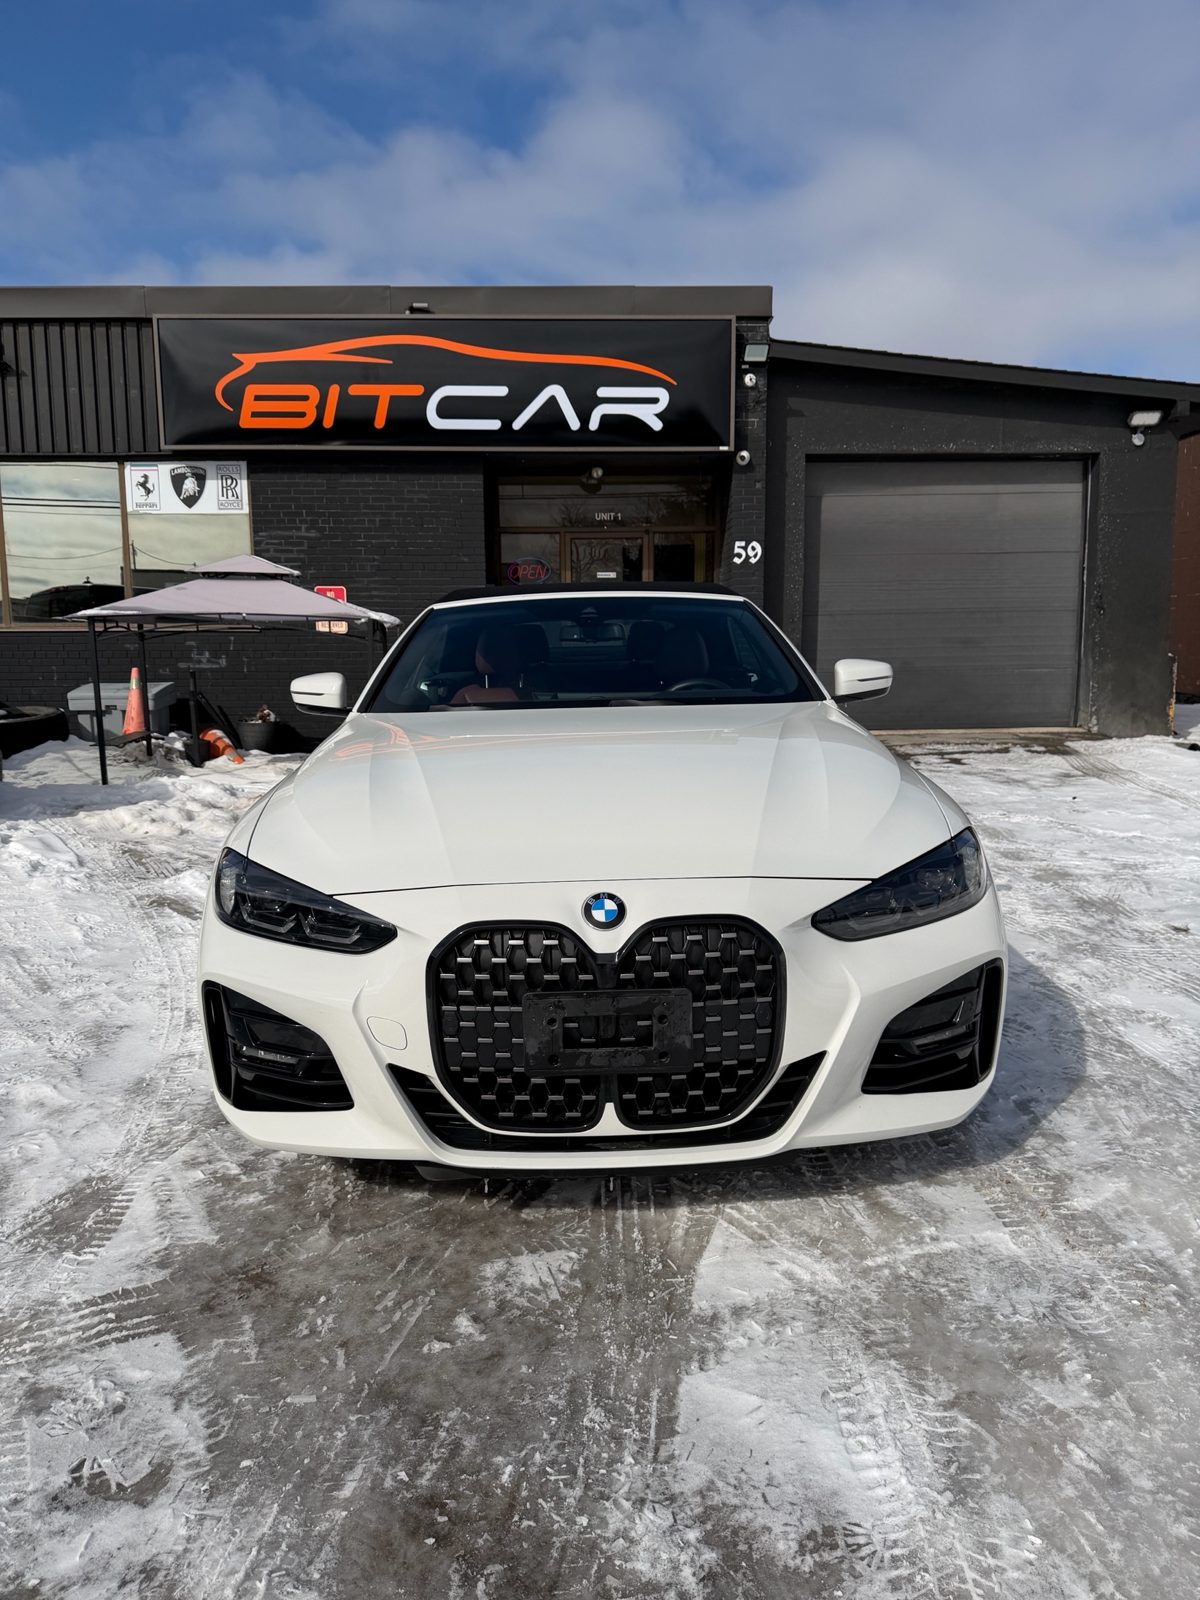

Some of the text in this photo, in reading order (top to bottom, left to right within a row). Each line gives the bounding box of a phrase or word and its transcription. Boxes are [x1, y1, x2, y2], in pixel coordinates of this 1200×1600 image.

[239, 384, 669, 431] BITCAR
[595, 512, 622, 521] UNIT 1
[733, 541, 762, 564] 59
[508, 564, 547, 579] OPEN
[587, 893, 622, 905] BMW
